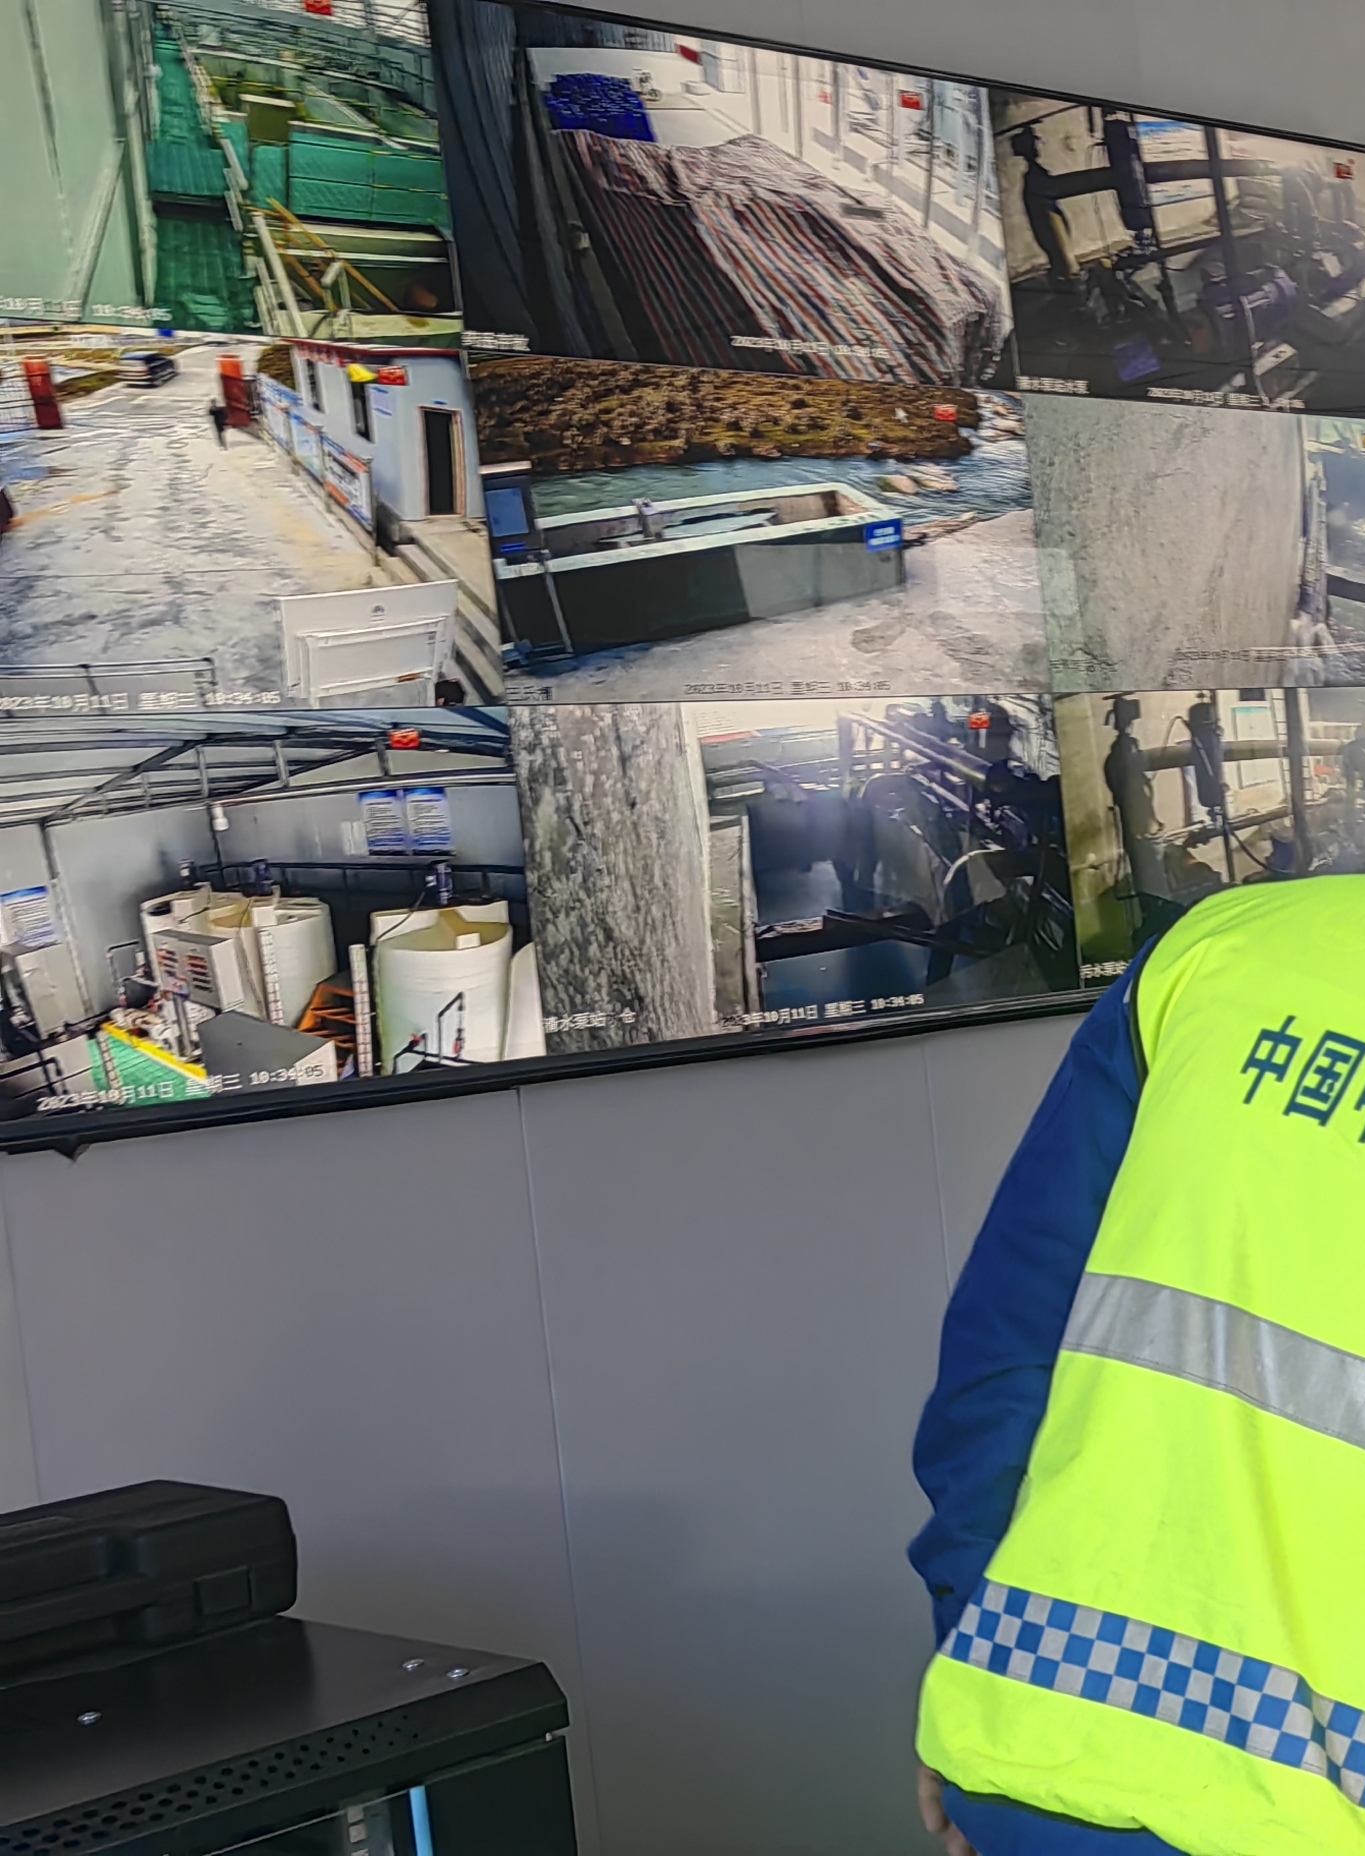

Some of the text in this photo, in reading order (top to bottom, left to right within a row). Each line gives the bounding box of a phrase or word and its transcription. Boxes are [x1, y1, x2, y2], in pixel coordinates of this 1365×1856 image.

[36, 1081, 174, 1112] 2023年10月11日
[185, 1073, 242, 1097] 星期三
